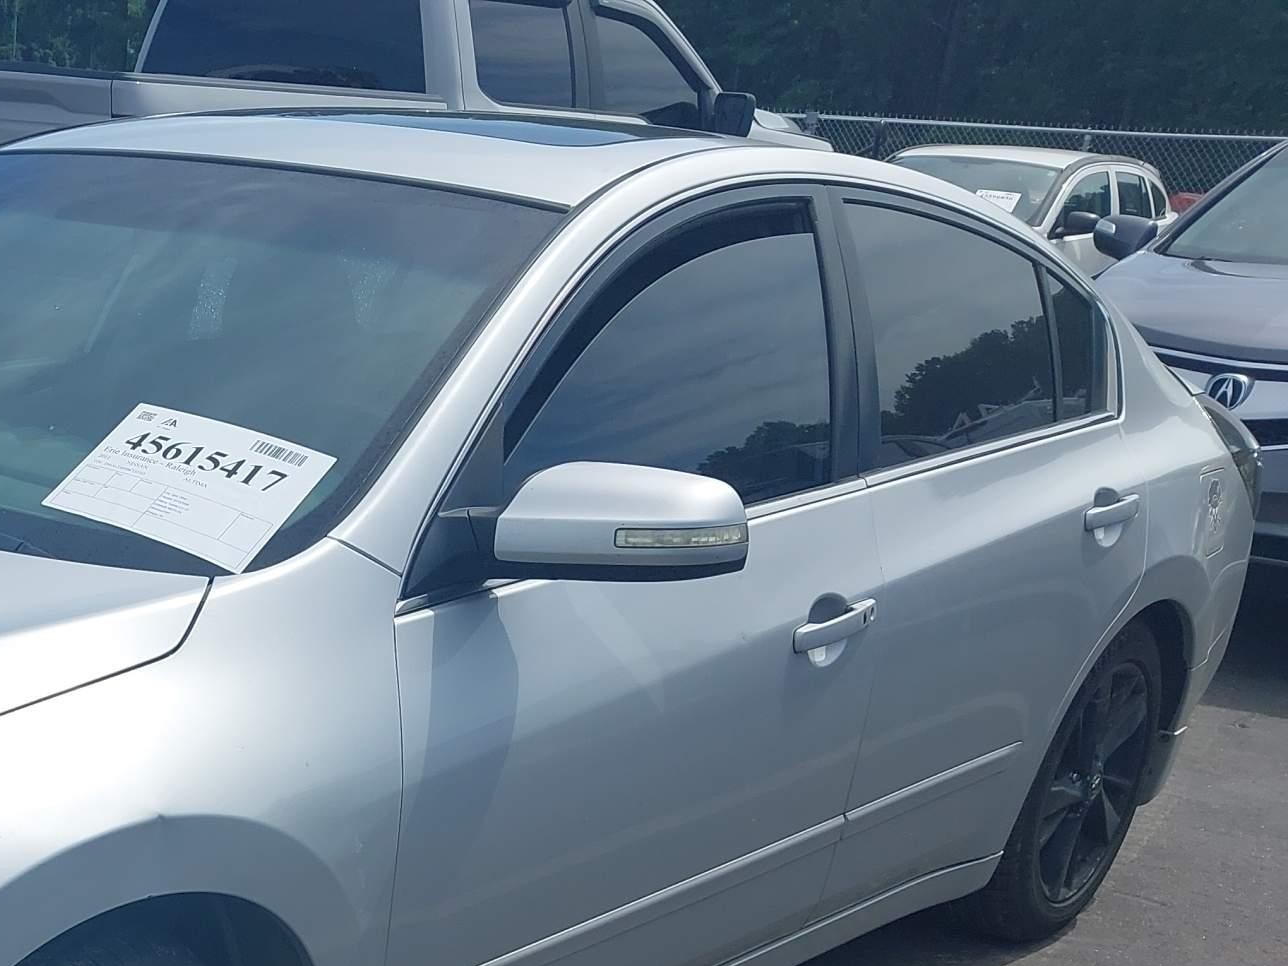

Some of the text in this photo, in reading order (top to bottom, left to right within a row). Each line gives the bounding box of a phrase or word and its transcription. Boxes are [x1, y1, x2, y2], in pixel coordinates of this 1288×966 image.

[103, 445, 120, 454] Erie
[121, 450, 159, 464] Insurance
[165, 461, 196, 476] Raleigh
[125, 432, 288, 491] 45615417
